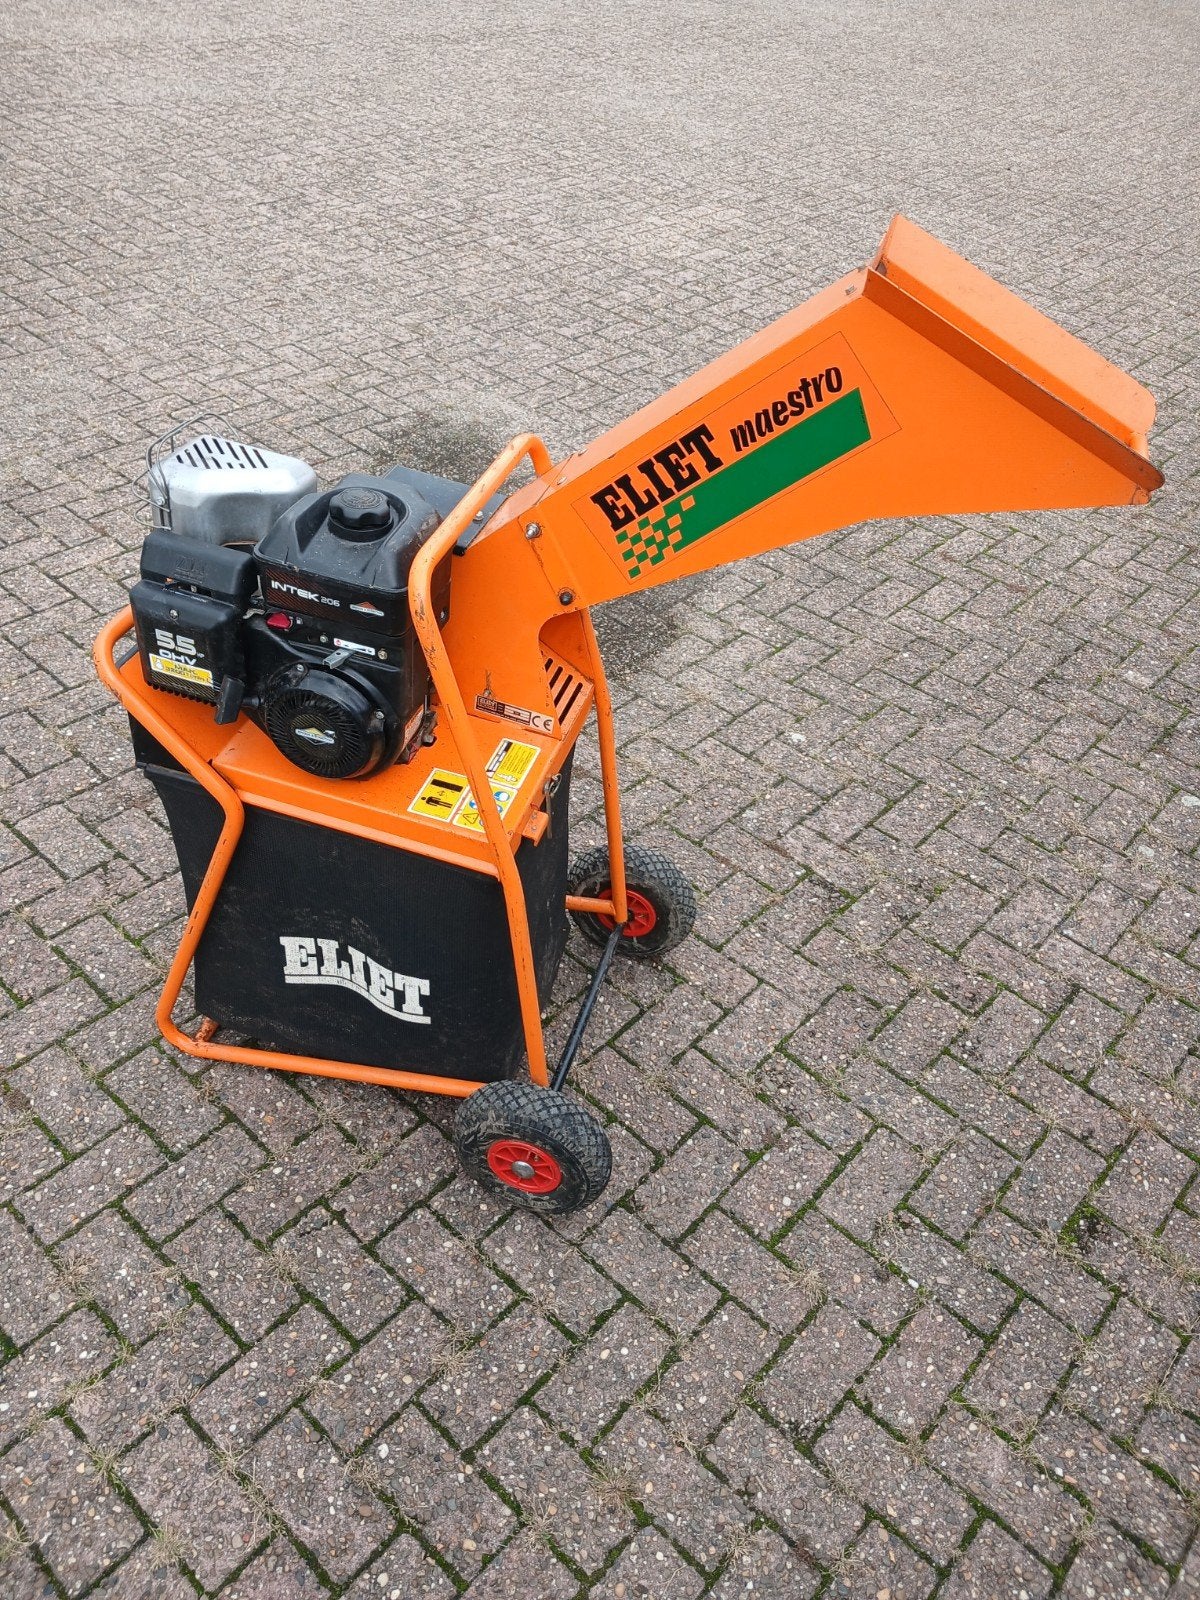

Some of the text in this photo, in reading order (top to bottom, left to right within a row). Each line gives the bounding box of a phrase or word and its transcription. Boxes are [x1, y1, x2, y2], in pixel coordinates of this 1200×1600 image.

[590, 366, 843, 532] ELIET maestro
[271, 580, 341, 607] INTEK 206
[159, 649, 197, 665] OHV
[532, 715, 553, 732] CE
[279, 936, 430, 1016] ELIET
